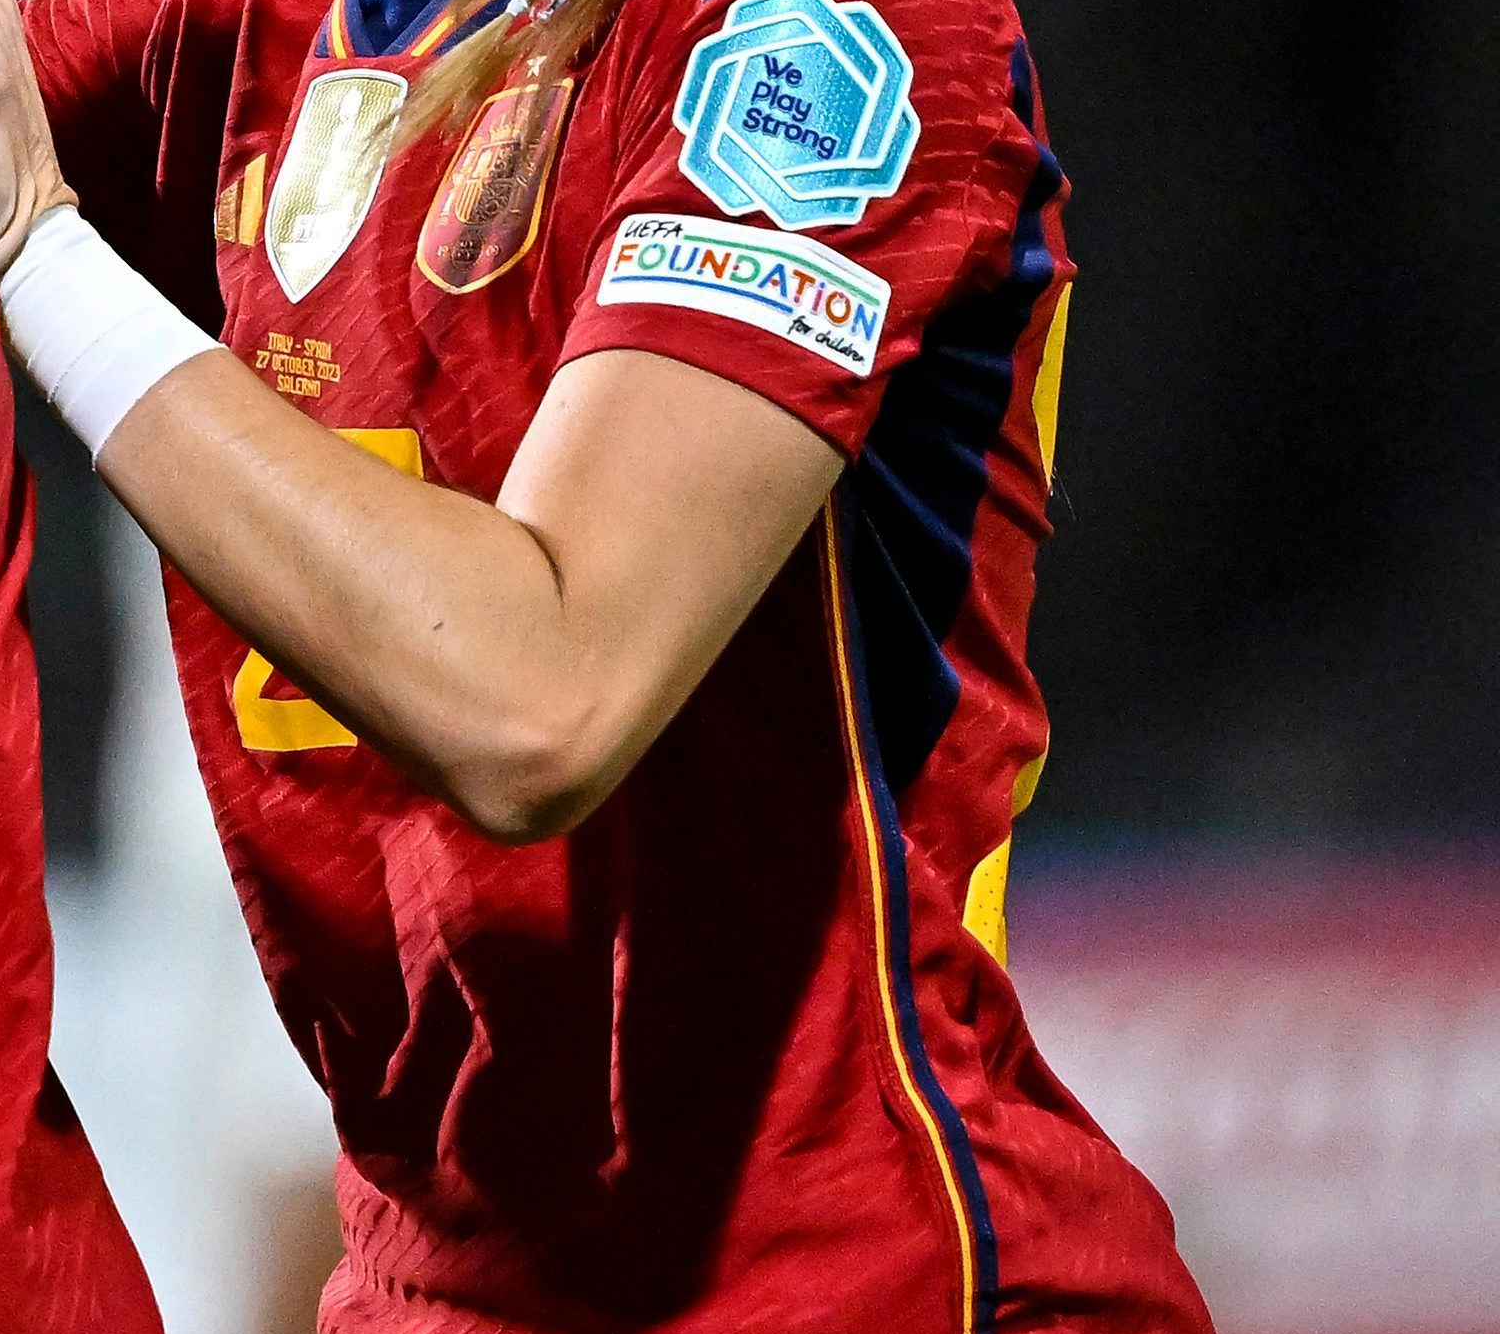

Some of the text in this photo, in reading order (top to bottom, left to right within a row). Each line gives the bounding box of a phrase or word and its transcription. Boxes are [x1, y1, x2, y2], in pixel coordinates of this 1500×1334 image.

[763, 54, 803, 87] We
[751, 81, 812, 123] Play
[742, 107, 838, 159] Strong
[624, 221, 684, 239] UEFA
[613, 242, 878, 342] FOUNDATION
[272, 353, 315, 377] OCTOBER
